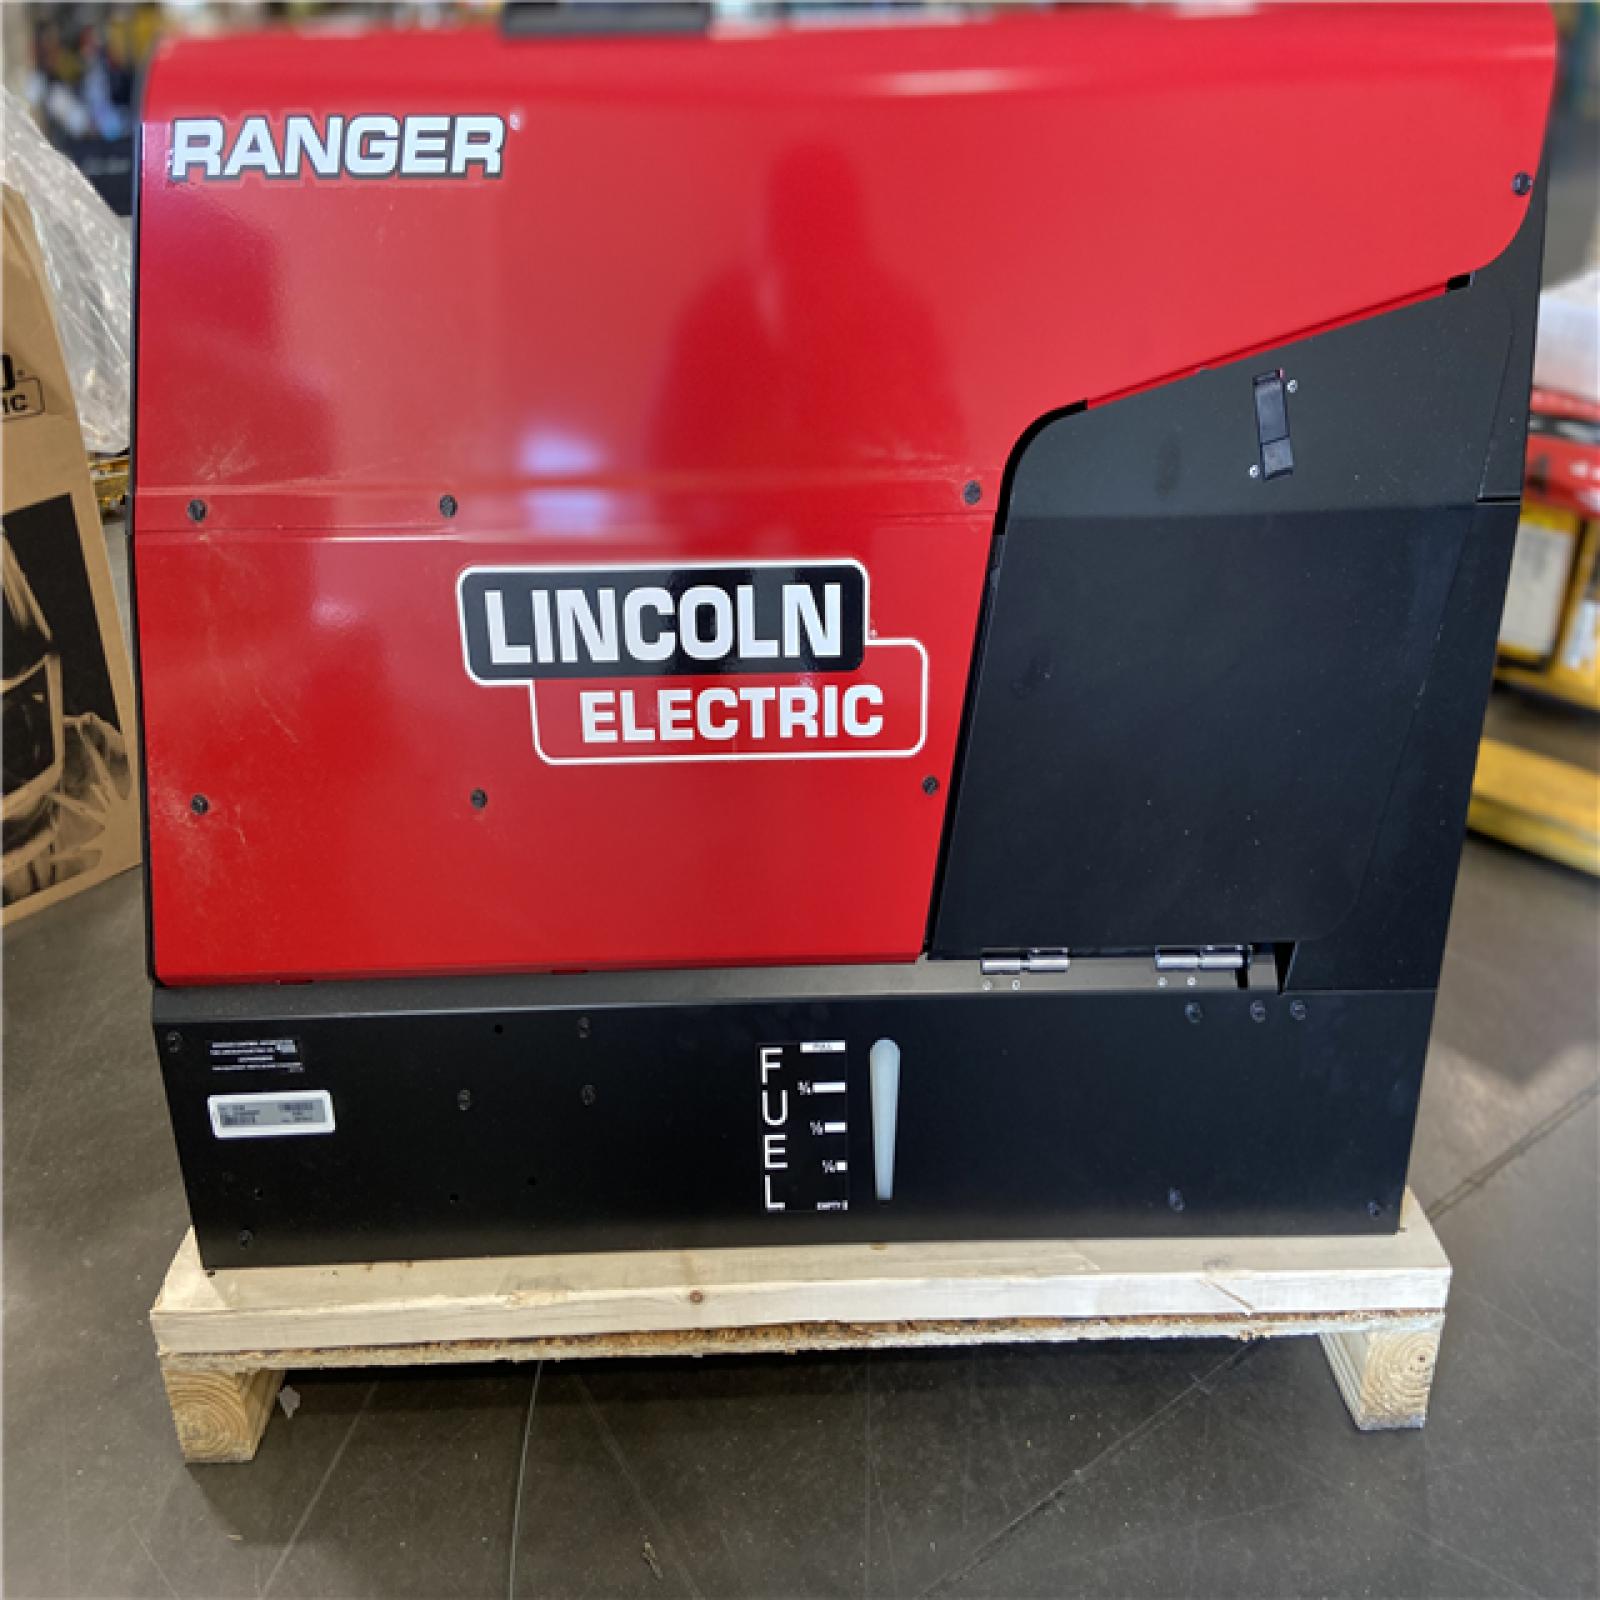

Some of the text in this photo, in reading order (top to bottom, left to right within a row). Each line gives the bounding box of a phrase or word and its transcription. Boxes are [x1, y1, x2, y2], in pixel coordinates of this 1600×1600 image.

[171, 114, 506, 179] RANGER
[484, 582, 842, 665] LINCOLN
[579, 683, 885, 744] ELECTRIC
[759, 1046, 789, 1212] FUEL
